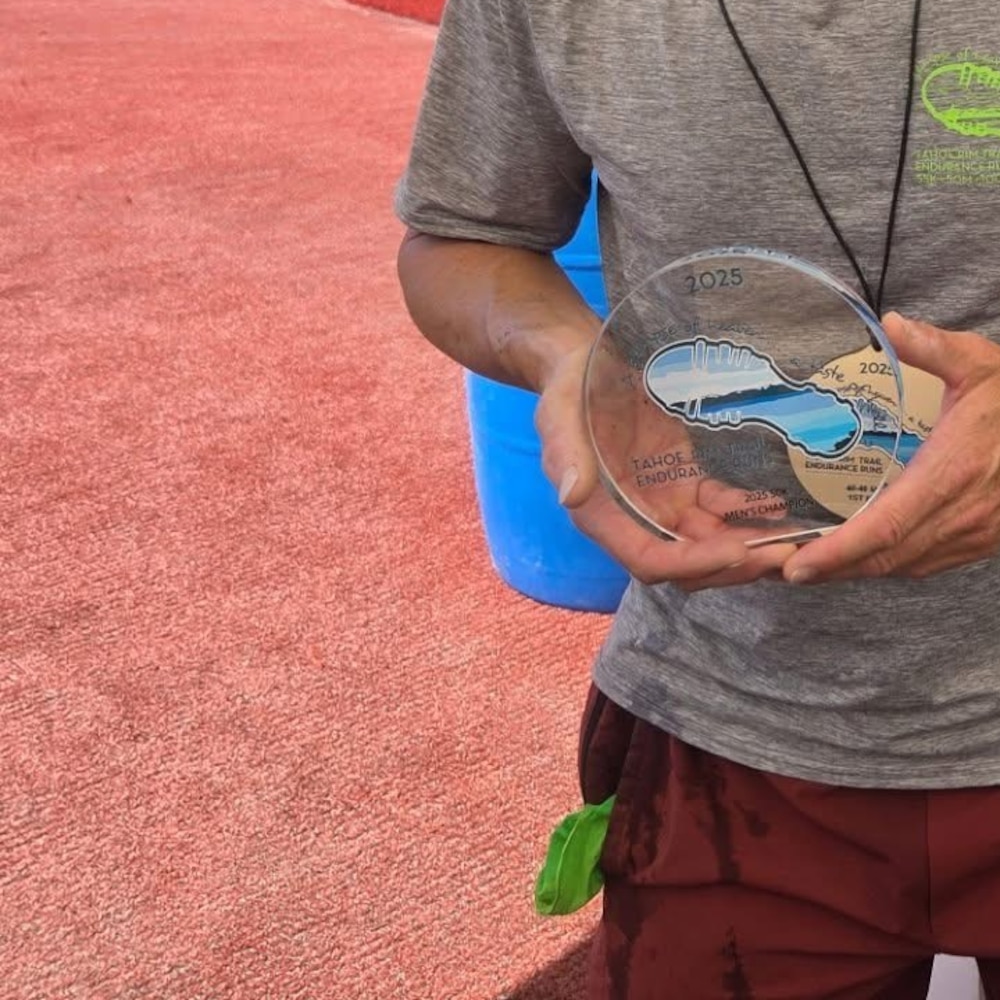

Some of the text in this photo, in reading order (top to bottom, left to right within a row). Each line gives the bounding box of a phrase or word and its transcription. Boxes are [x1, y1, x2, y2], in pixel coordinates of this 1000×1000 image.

[684, 267, 743, 294] 2025
[632, 452, 685, 471] TAHOE
[805, 461, 884, 475] ENDURANCE RUNS
